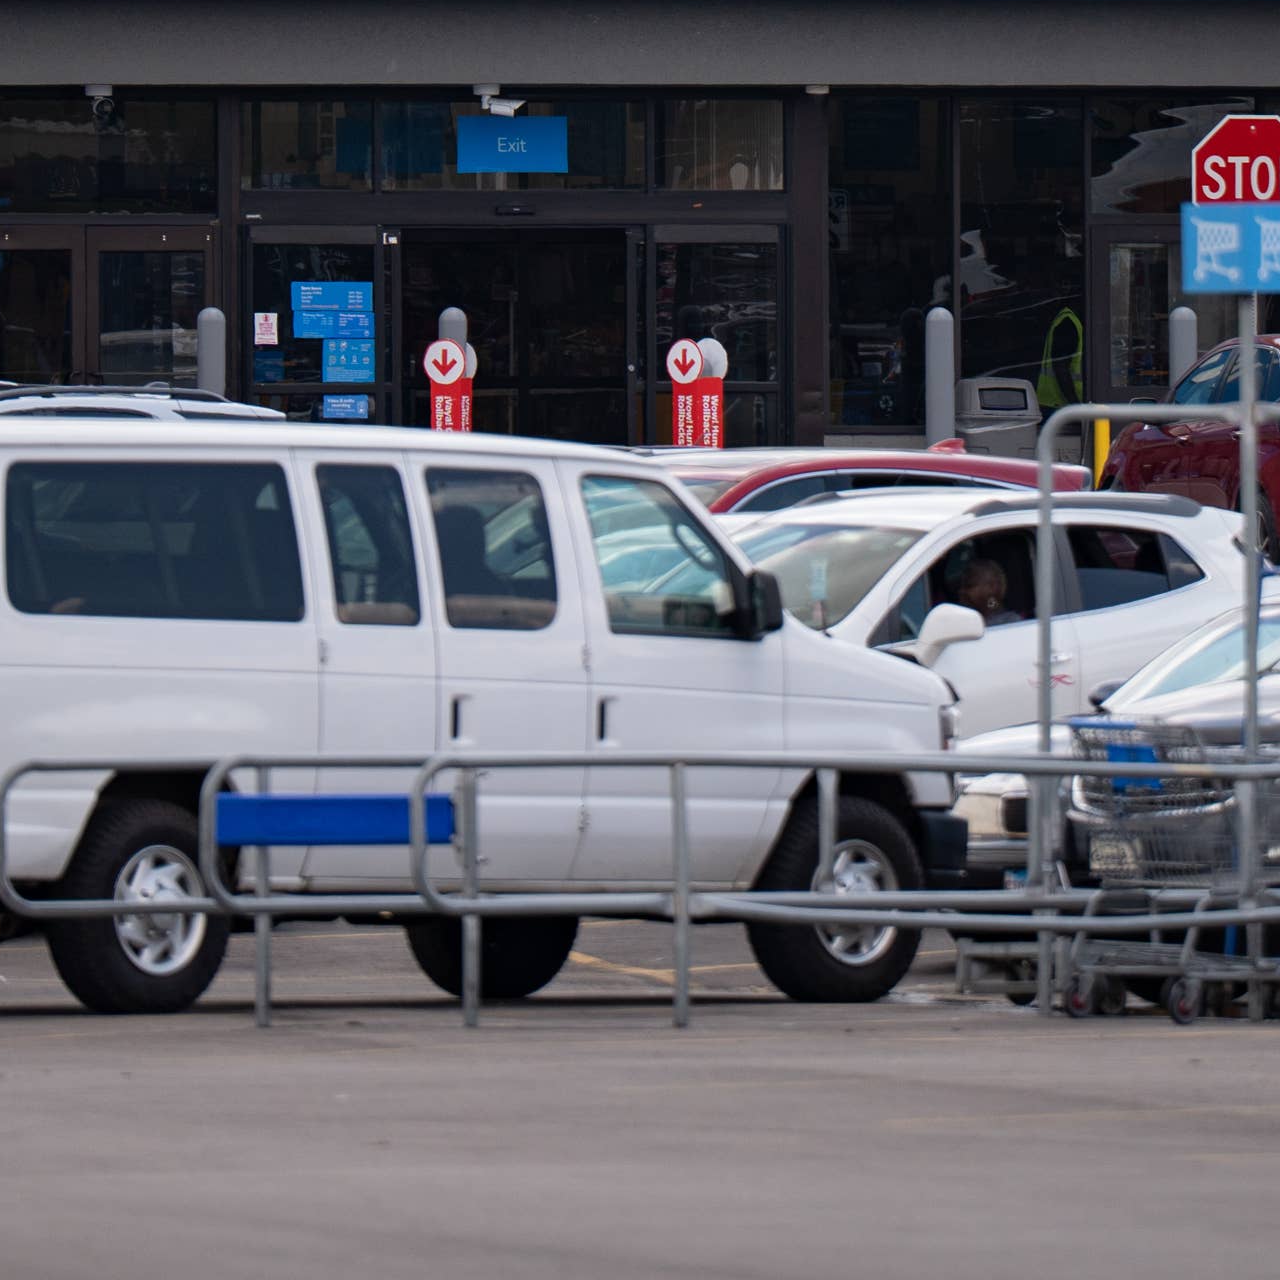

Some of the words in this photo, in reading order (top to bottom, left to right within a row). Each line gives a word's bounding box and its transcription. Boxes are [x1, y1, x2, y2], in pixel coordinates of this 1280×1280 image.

[497, 136, 527, 153] Exit
[702, 395, 710, 445] Rollbacks
[711, 395, 719, 424] Wow!
